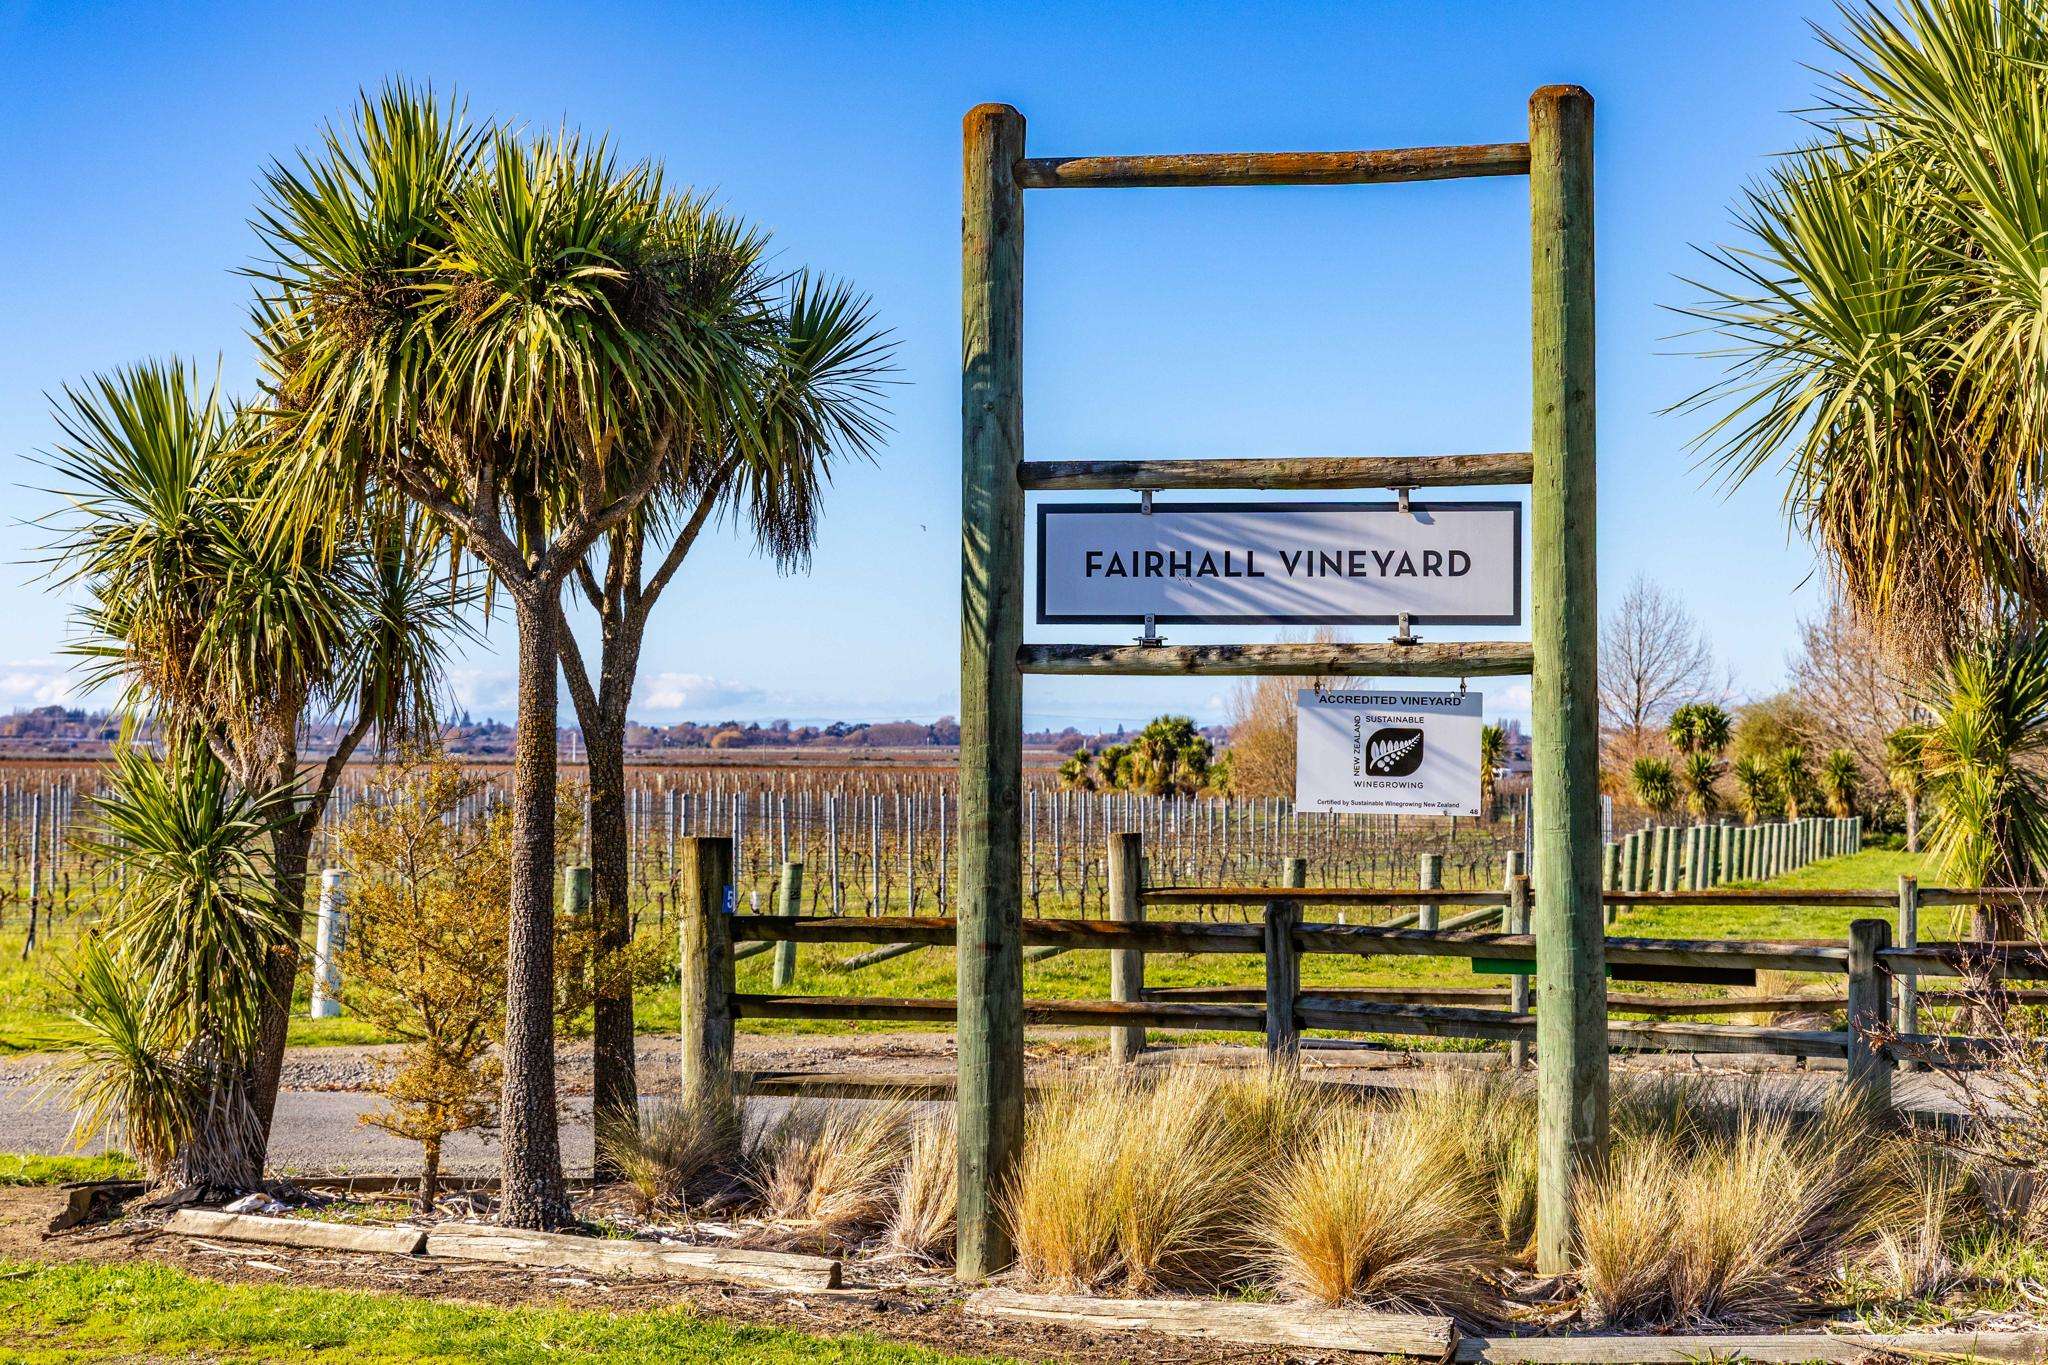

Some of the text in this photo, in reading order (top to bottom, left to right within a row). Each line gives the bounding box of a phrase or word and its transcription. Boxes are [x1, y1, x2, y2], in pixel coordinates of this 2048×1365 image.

[1085, 550, 1472, 578] FAIRHALL VINEYARD
[1319, 695, 1462, 706] ACCREDITED VINEYARD
[1365, 715, 1424, 724] SUSTAINABLE
[1353, 715, 1361, 754] ZEALAND
[1353, 780, 1424, 789] WINEGROWING
[1385, 800, 1422, 808] Winegrowing
[727, 890, 733, 909] 5
